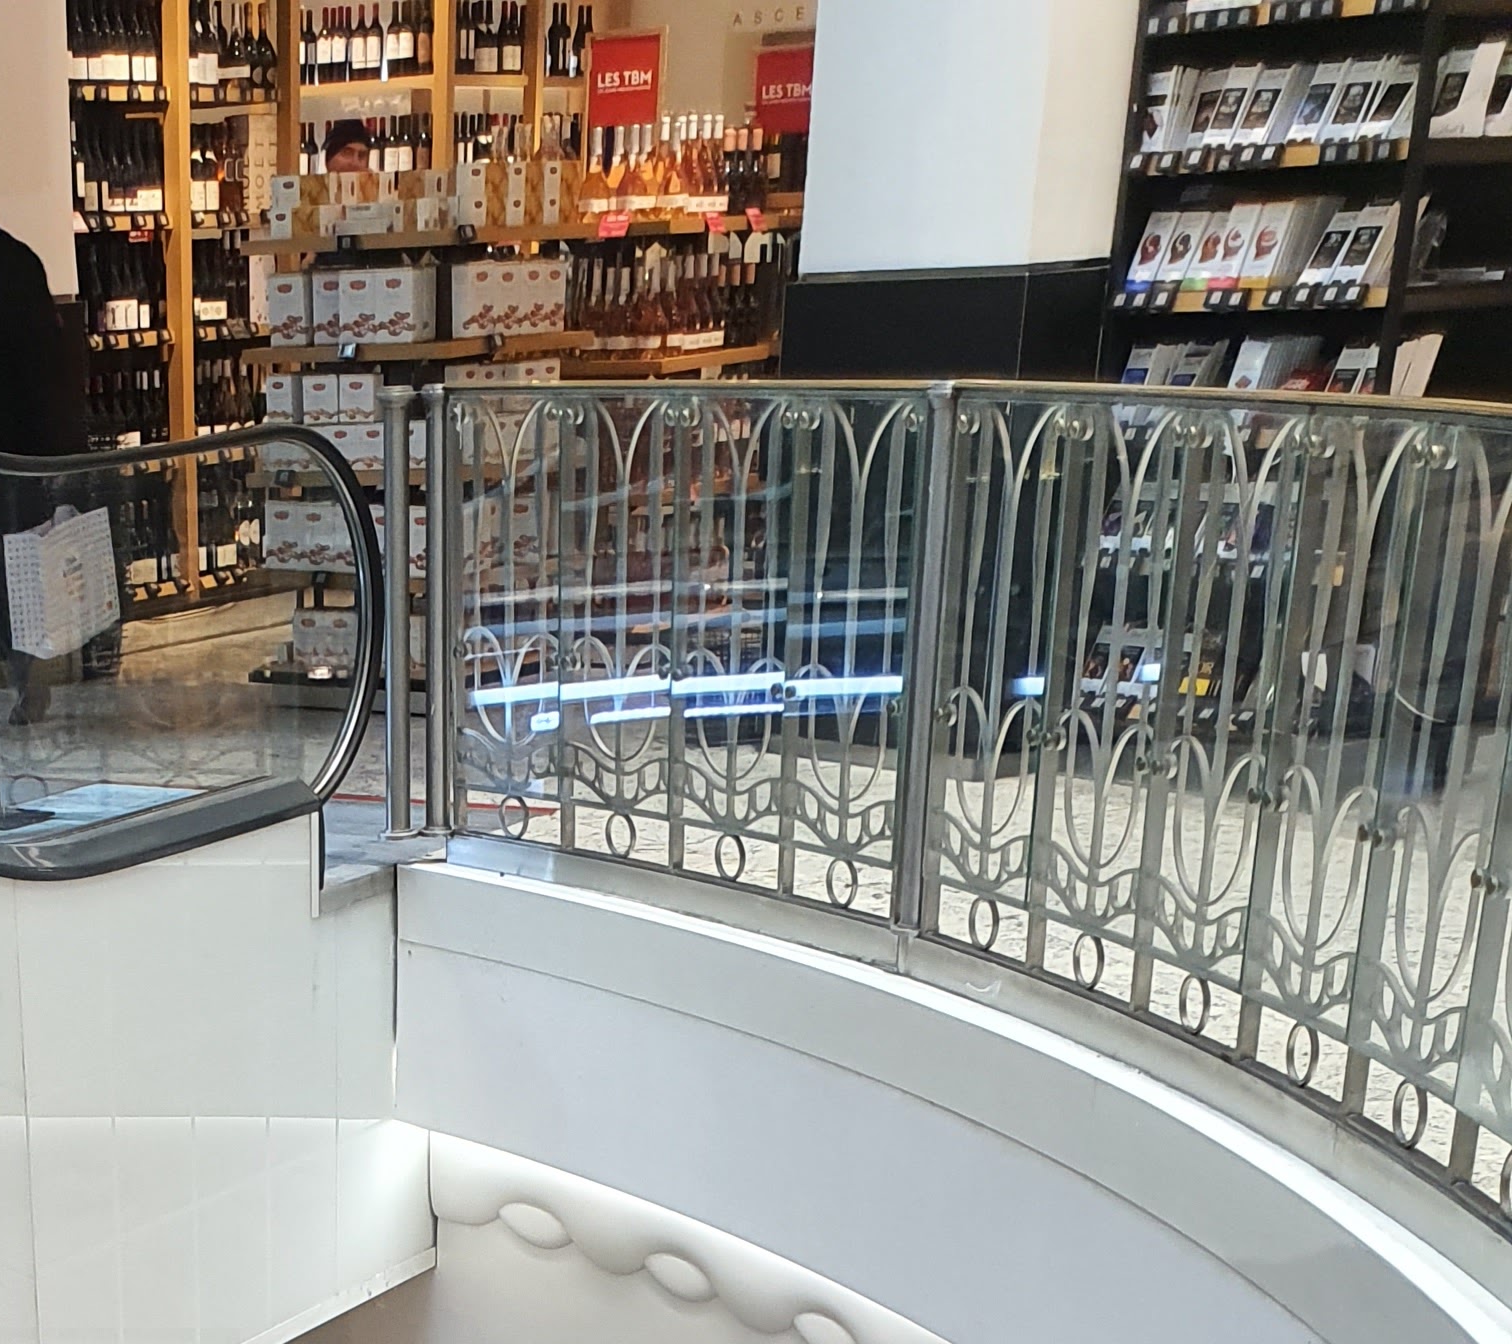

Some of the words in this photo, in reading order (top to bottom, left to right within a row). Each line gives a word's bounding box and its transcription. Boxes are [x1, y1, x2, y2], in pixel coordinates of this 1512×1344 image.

[597, 72, 620, 88] LES
[623, 69, 653, 86] TBM
[762, 84, 783, 100] LES
[786, 82, 812, 98] TBM
